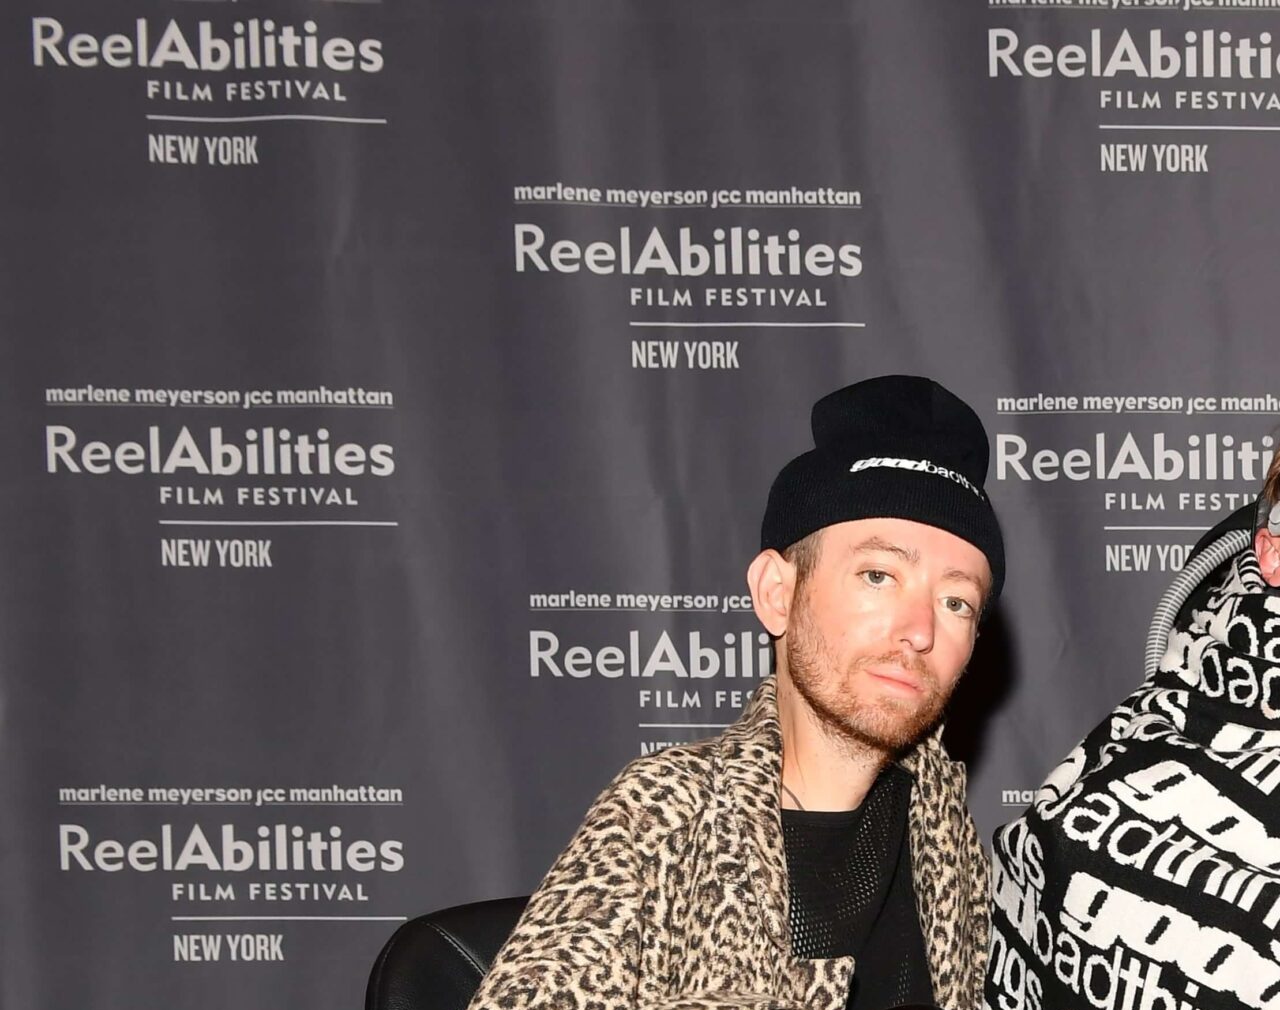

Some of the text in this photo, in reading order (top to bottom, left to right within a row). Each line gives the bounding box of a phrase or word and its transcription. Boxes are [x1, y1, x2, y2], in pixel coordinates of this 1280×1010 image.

[32, 17, 384, 72] ReelAbilities
[147, 80, 347, 101] FILM FESTIVAL
[1100, 90, 1161, 109] FILM
[148, 134, 259, 165] NEW YORK
[1100, 144, 1209, 172] NEW YORK
[514, 183, 862, 208] marlene meyerson jcc manhattan
[514, 223, 862, 276] ReelAbilities
[631, 288, 827, 307] FILM FESTIVAL
[632, 341, 739, 369] NEW YORK
[46, 385, 393, 409] marlene meyerson jcc manhattan
[997, 393, 1078, 412] marlene
[1083, 396, 1183, 413] meyerson
[1186, 397, 1216, 415] jcc
[46, 425, 395, 476] ReelAbilities
[160, 486, 358, 505] FILM FESTIVAL
[1105, 493, 1165, 510] FILM
[161, 539, 272, 567] NEW YORK
[1105, 545, 1151, 572] NEW
[530, 590, 611, 608] marlene
[616, 594, 718, 611] meyerson
[639, 691, 701, 708] FILM
[59, 784, 403, 806] marlene meyerson jcc manhattan
[59, 824, 404, 872] ReelAbilities
[172, 883, 369, 901] FILM FESTIVAL
[173, 934, 284, 961] NEW YORK
